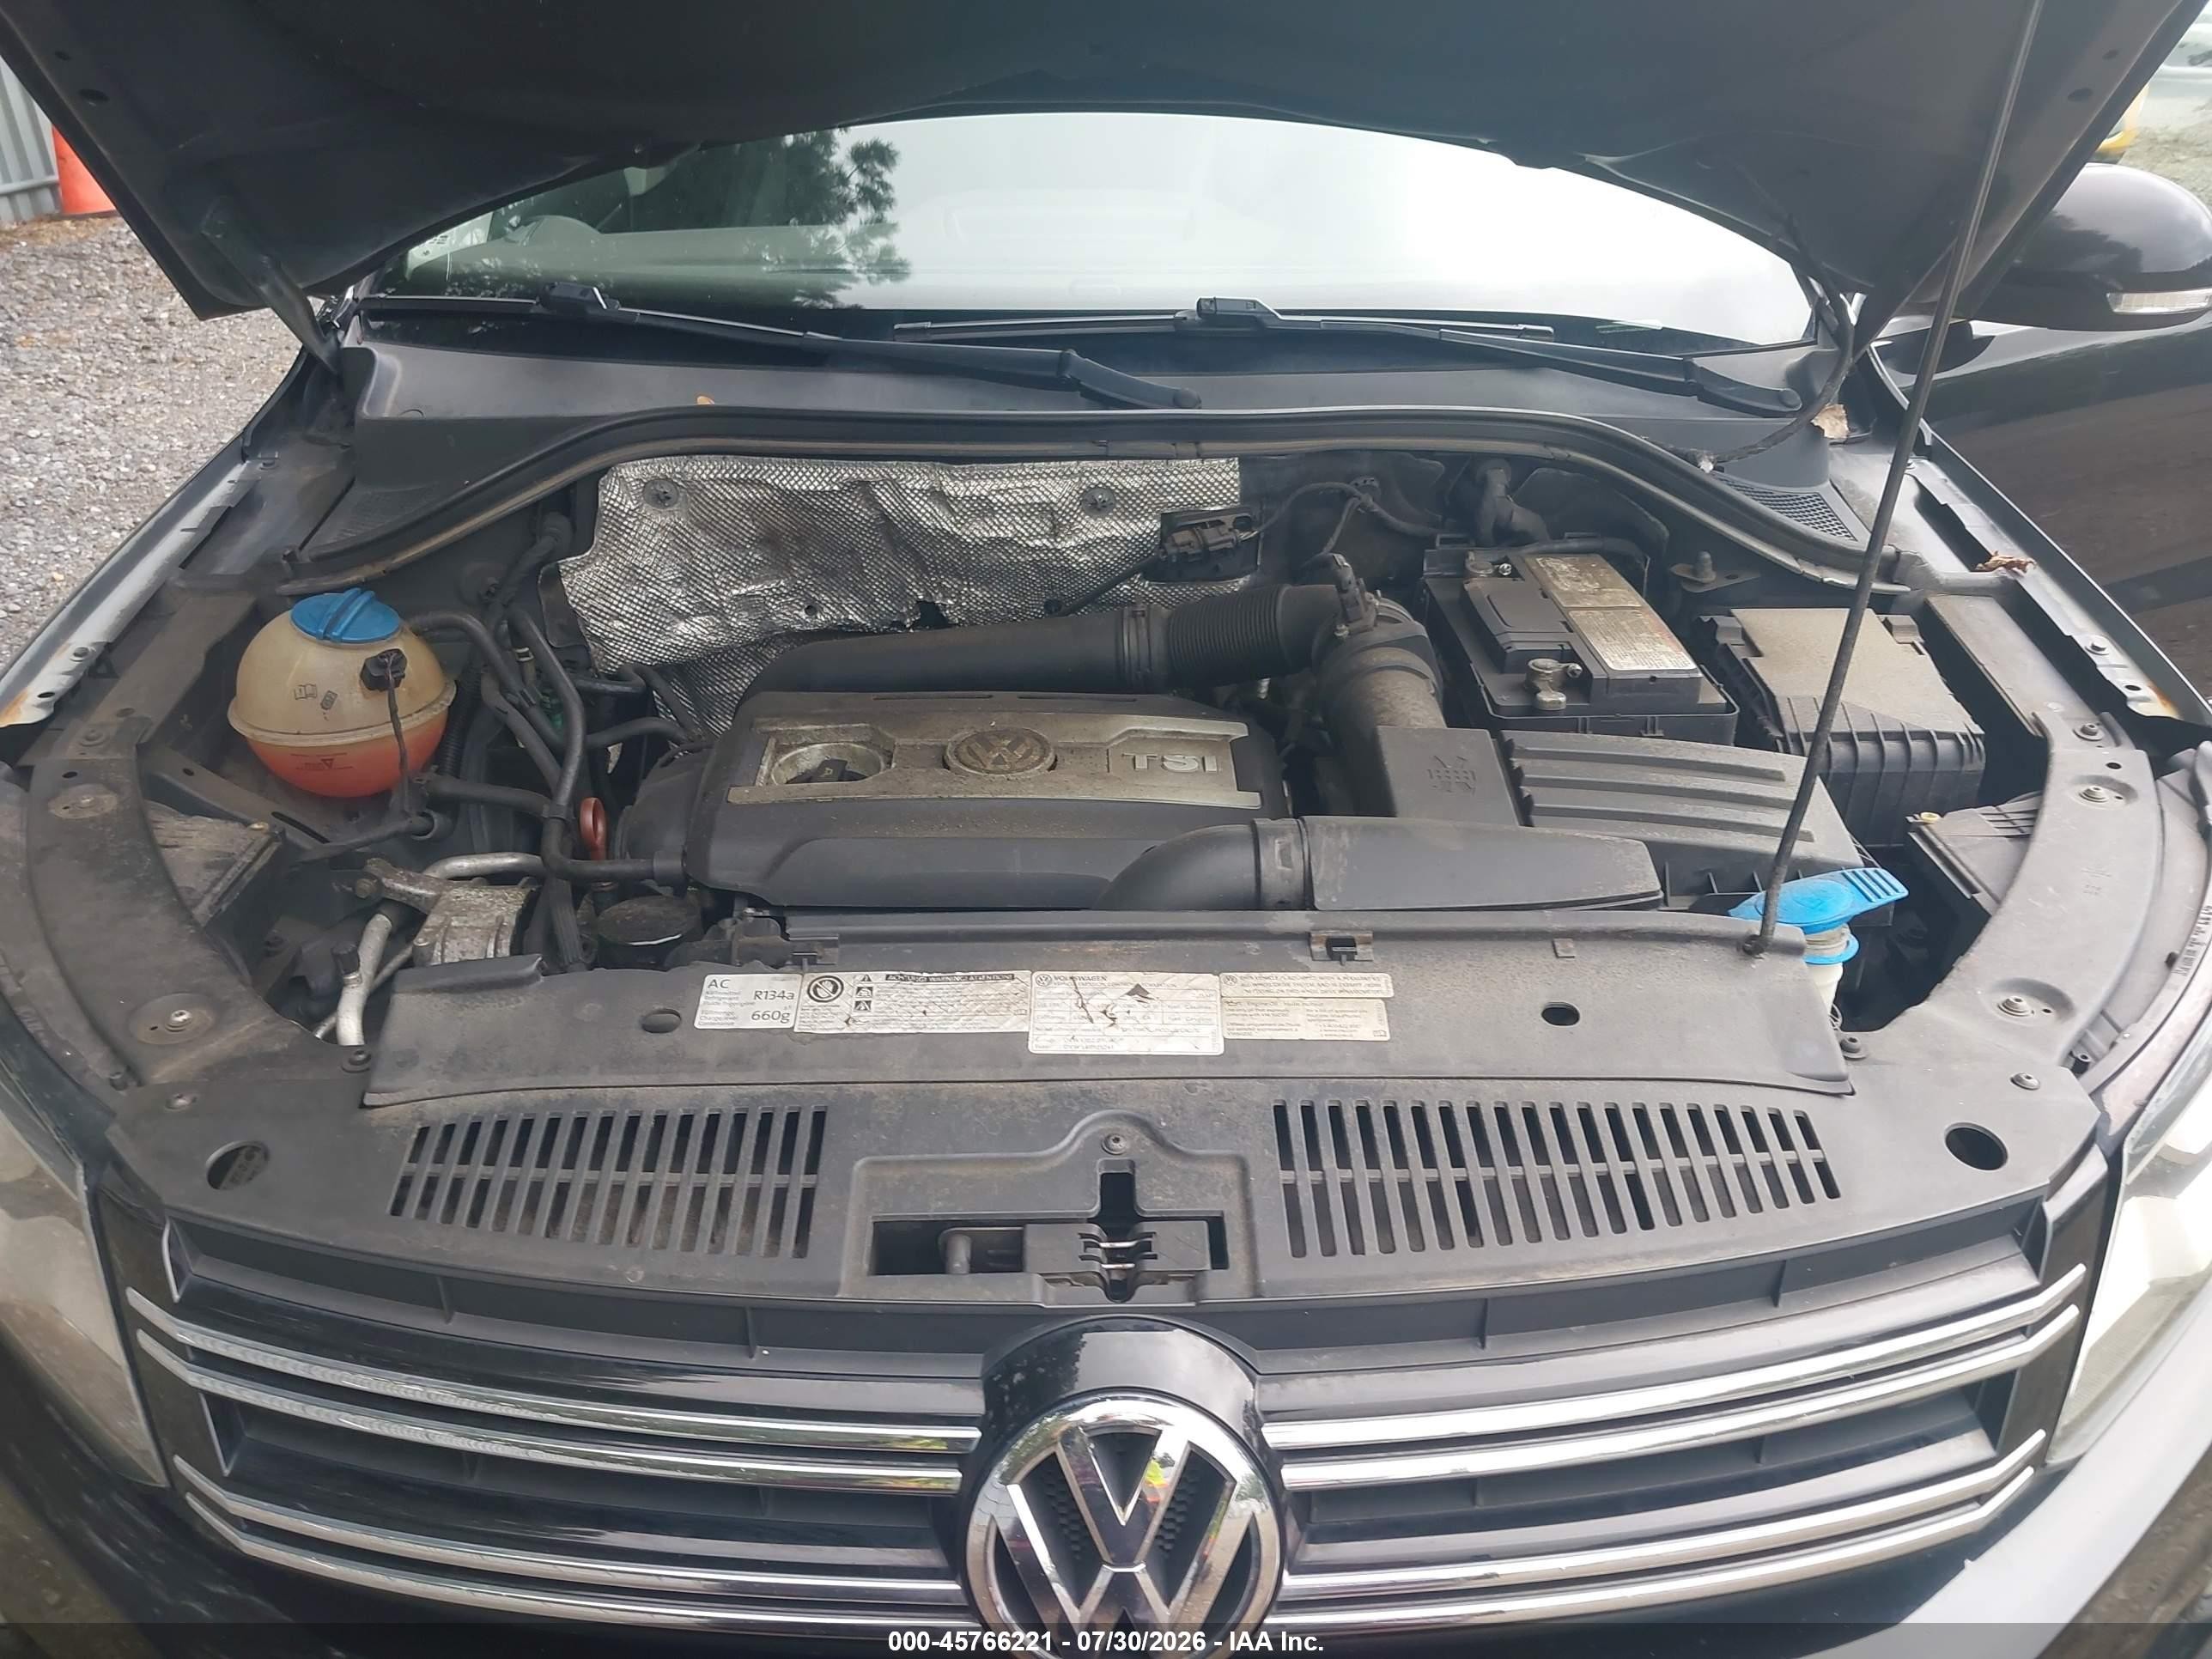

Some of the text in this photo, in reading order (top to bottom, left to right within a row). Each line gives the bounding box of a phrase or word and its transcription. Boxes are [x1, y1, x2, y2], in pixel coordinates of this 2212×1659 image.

[1123, 752, 1218, 774] TSI
[707, 978, 731, 989] AC
[753, 990, 795, 1000] R134a
[750, 1010, 791, 1024] 660g
